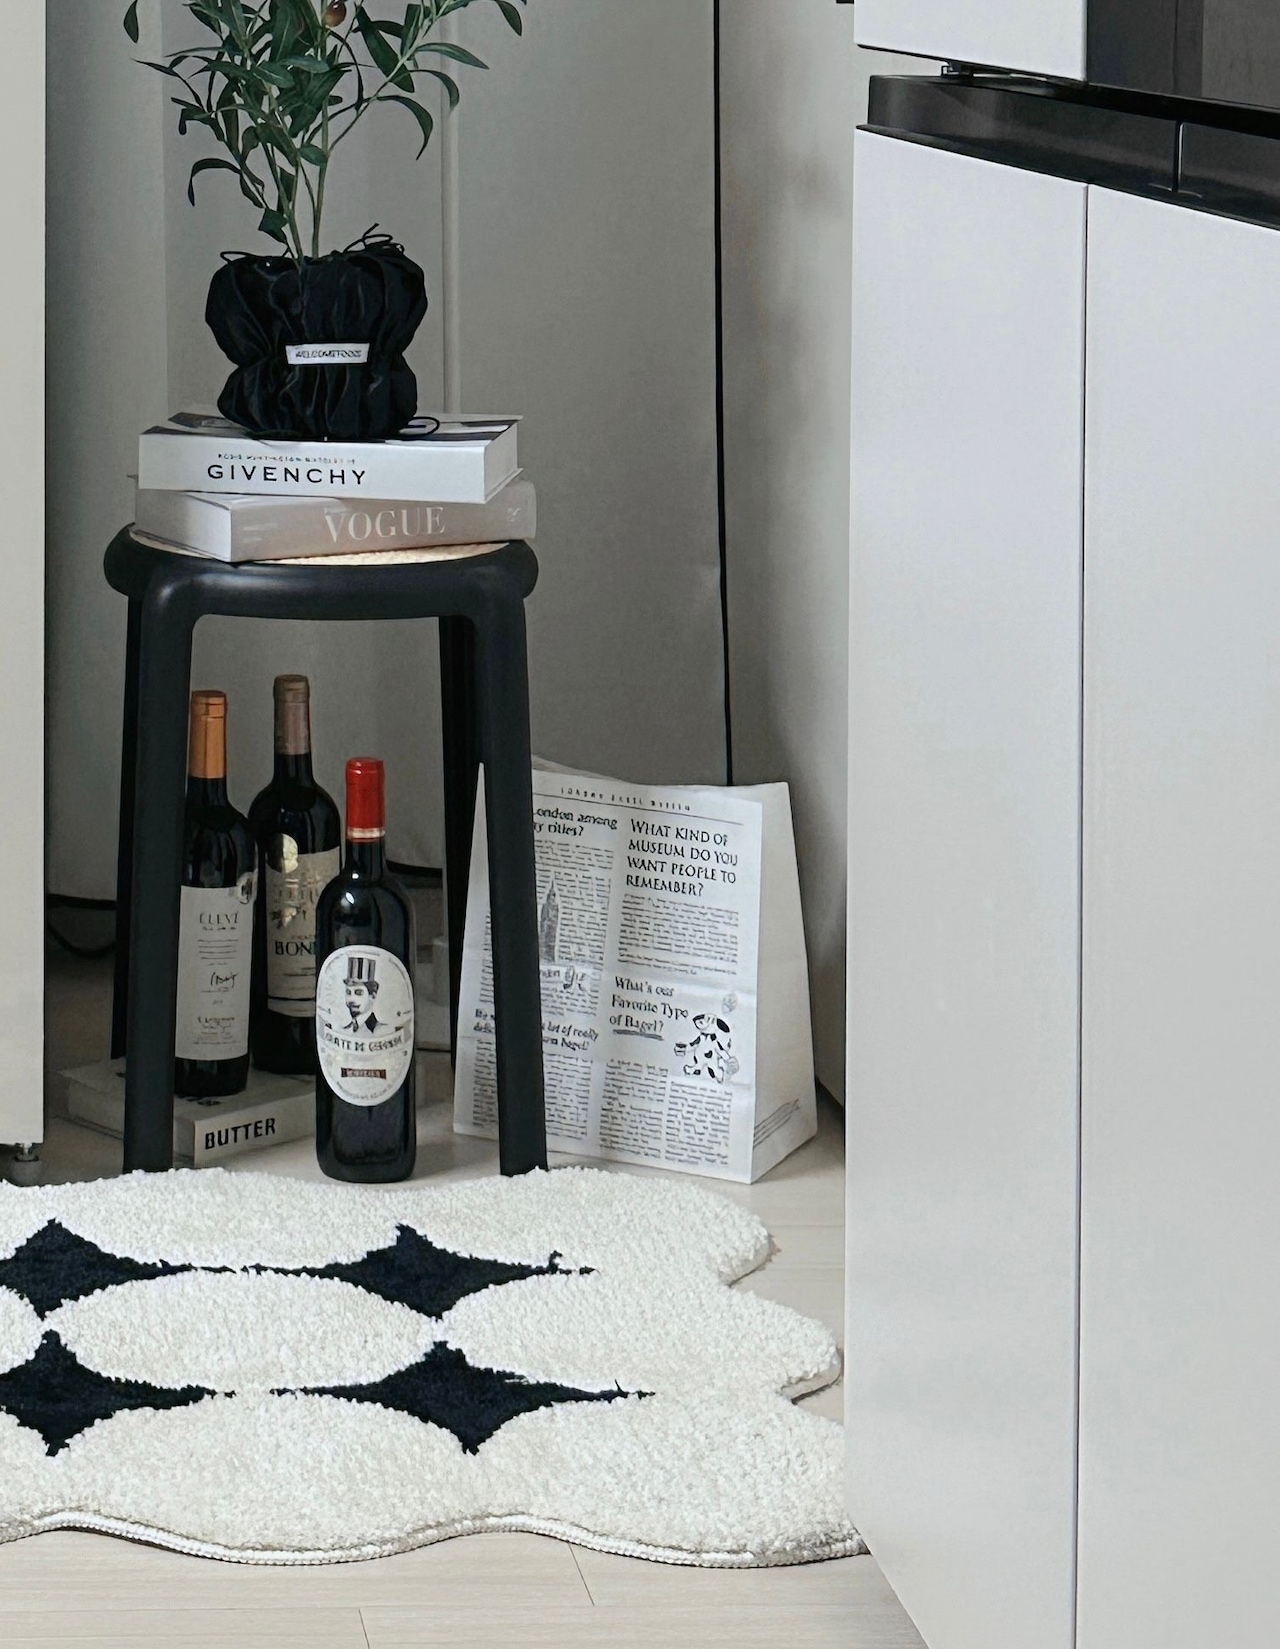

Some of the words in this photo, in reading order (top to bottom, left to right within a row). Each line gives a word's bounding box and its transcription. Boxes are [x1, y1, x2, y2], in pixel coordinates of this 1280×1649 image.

[207, 463, 366, 485] GIVENCHY
[323, 506, 446, 544] VOGUE
[533, 807, 574, 822] ondon
[577, 813, 618, 831] among
[630, 818, 672, 839] WHAT
[675, 826, 711, 844] KIND
[712, 833, 729, 847] OF
[628, 838, 686, 859] MUSEUM
[690, 846, 712, 862] DO
[713, 850, 739, 867] YOU
[626, 855, 668, 874] WANT
[671, 861, 718, 882] PEOPLE
[720, 870, 737, 885] TO
[625, 874, 705, 898] REMEMBER?
[614, 975, 653, 995] What's
[609, 1014, 623, 1027] of
[204, 1117, 276, 1151] BUTTER
